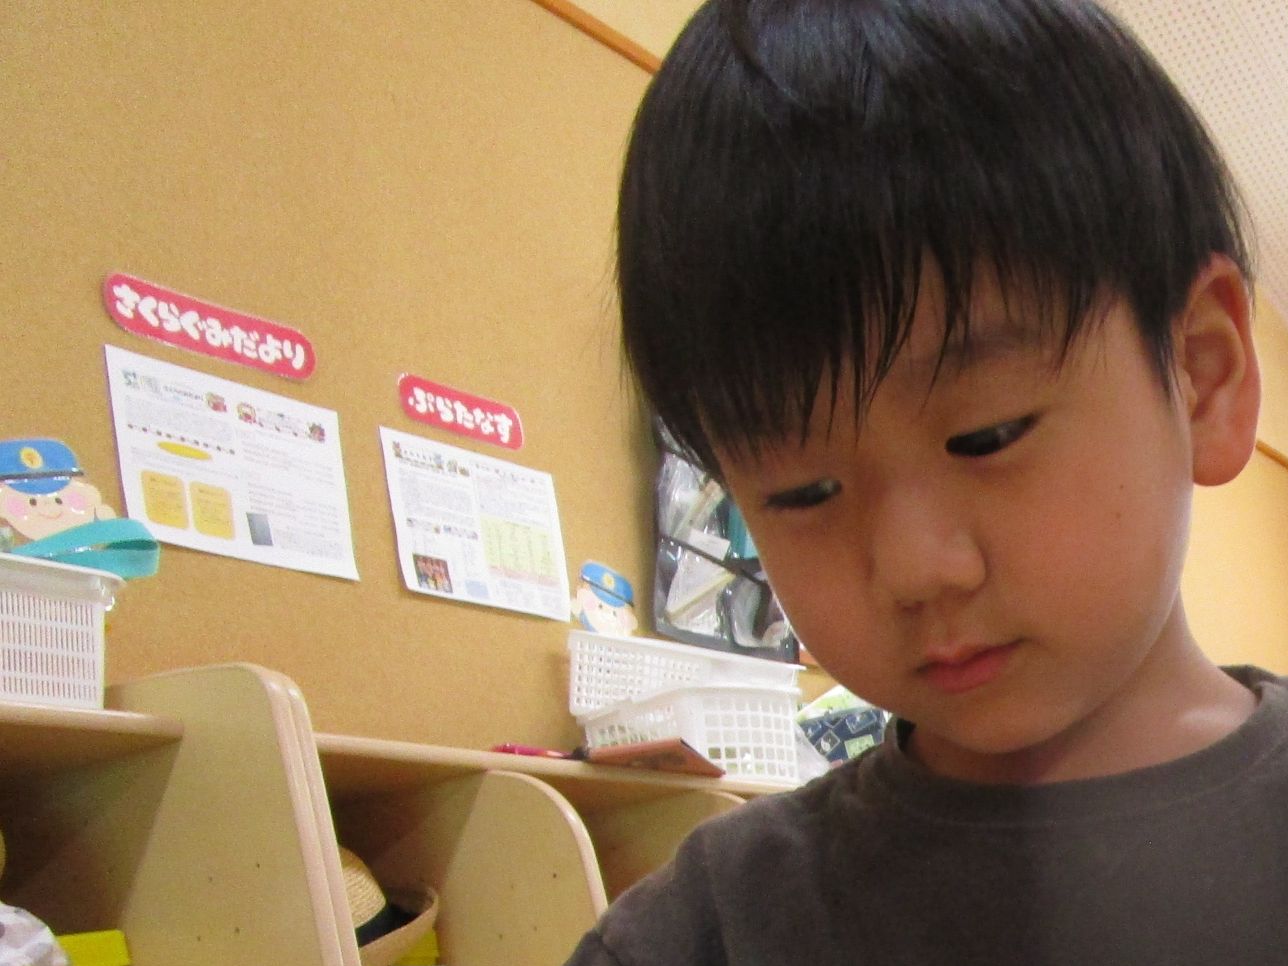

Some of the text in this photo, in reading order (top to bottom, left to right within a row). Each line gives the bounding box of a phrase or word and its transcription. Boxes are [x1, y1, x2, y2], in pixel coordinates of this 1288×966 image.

[112, 283, 305, 370] さくらぐみだより
[407, 386, 513, 444] ぷらたなす
